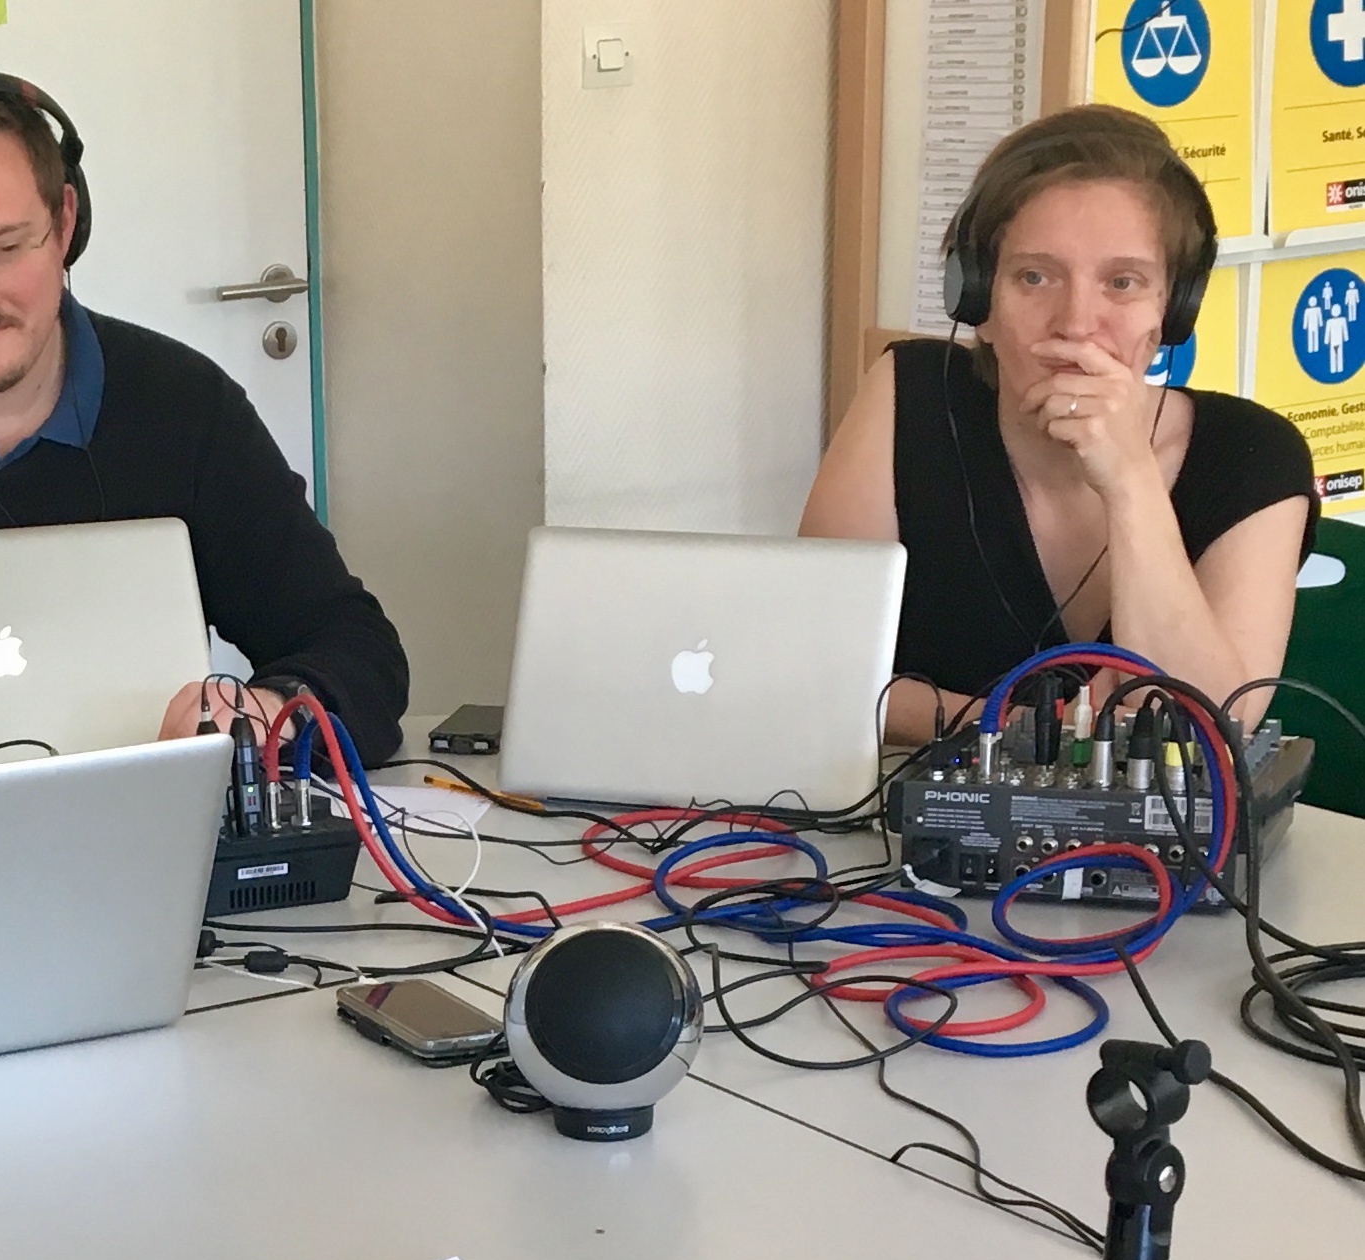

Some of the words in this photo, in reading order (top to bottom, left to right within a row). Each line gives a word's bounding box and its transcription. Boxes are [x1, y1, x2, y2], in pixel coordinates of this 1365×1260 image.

[1322, 128, 1355, 143] Santé,
[1183, 143, 1226, 159] Sécurité
[1326, 474, 1363, 492] onisep
[924, 790, 991, 804] PHONIC
